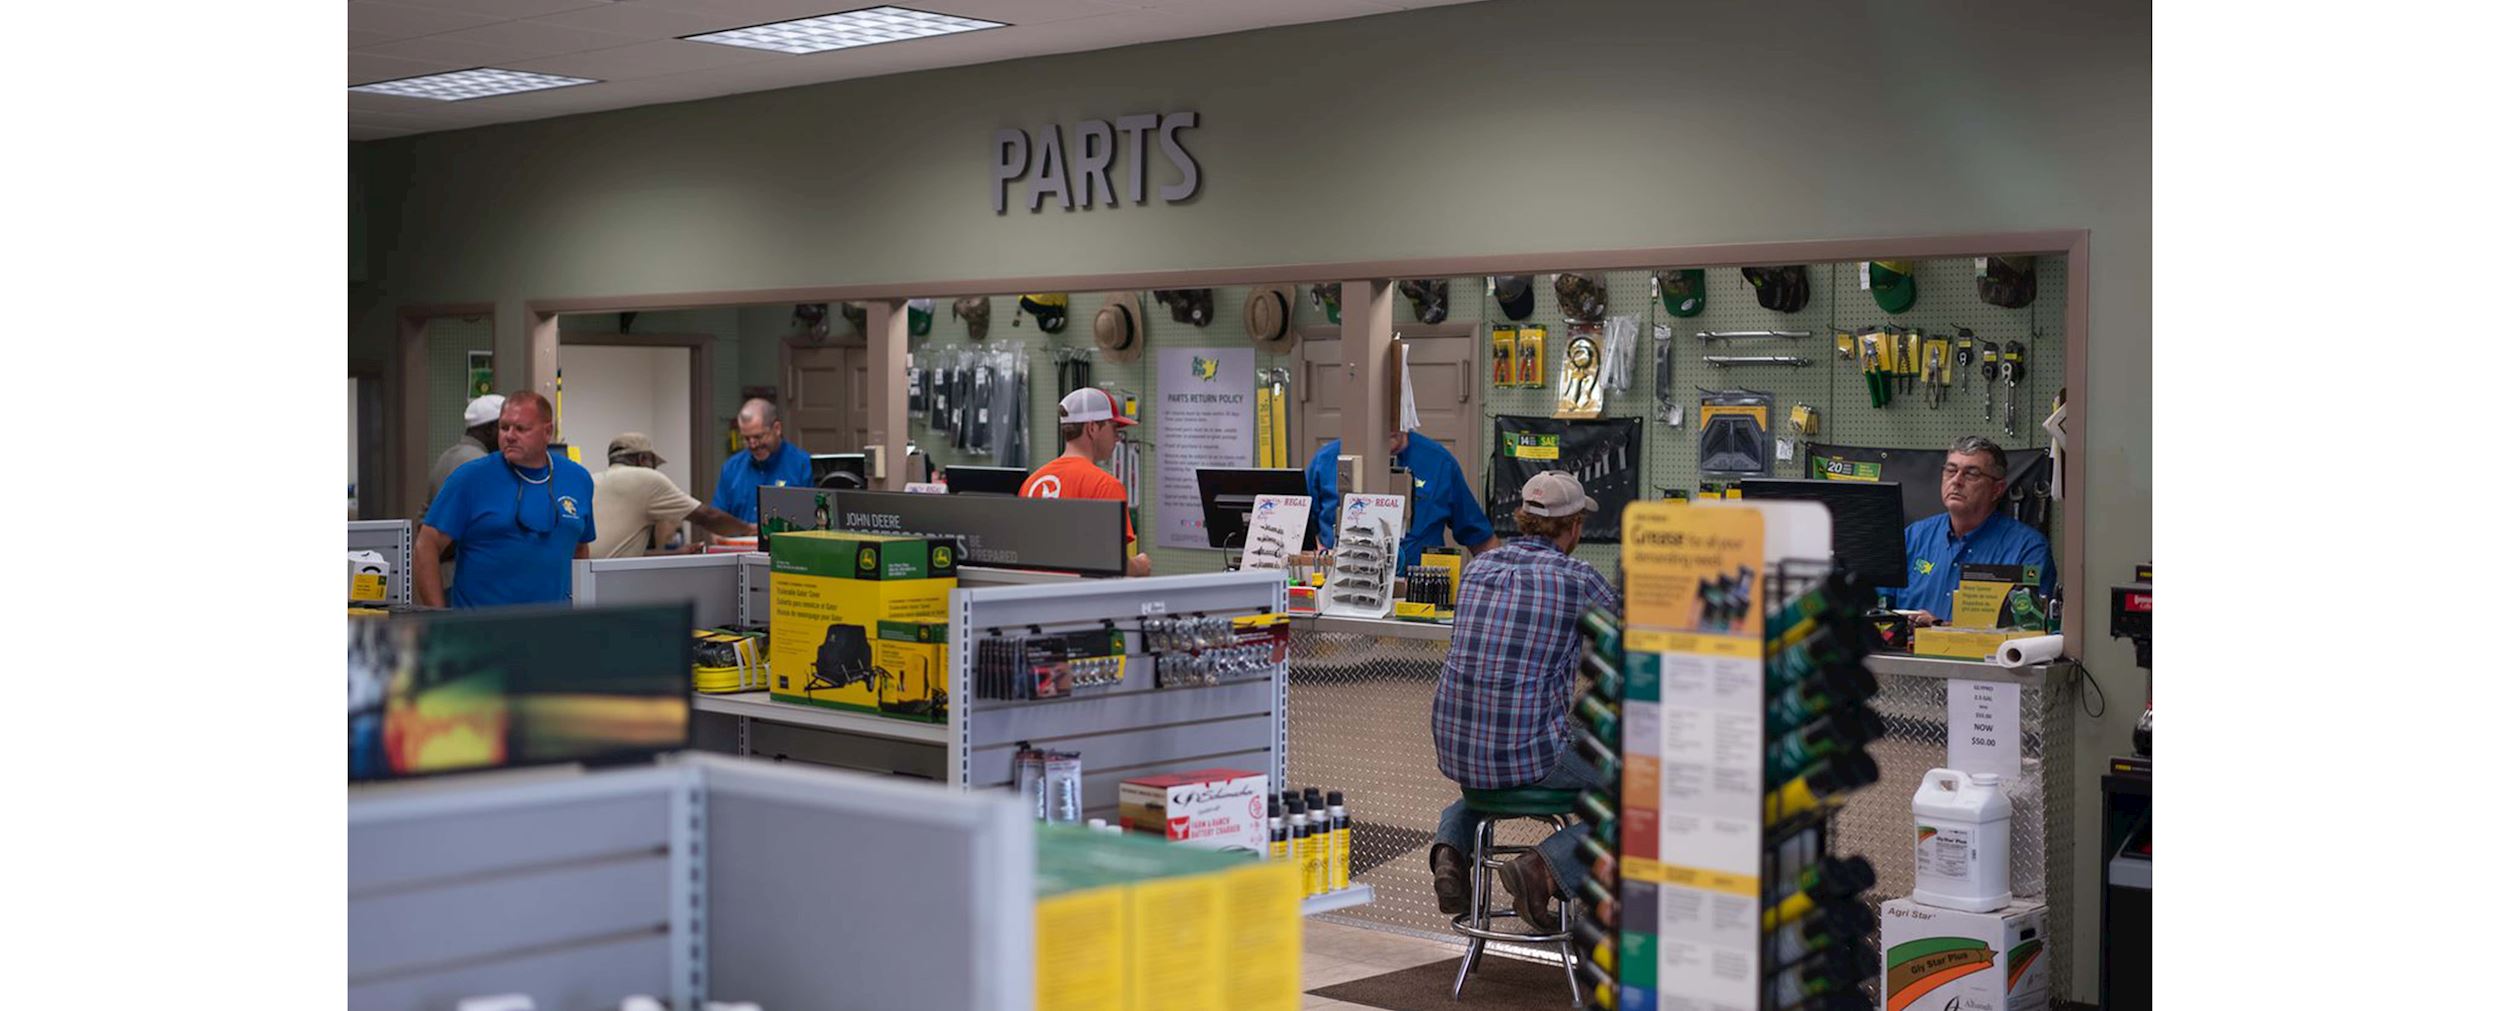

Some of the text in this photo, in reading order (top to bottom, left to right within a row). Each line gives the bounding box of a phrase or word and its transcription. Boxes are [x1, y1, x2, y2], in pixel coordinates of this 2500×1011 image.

[992, 111, 1199, 213] PARTS
[1167, 393, 1243, 404] PARTS RETURN POLICY
[1540, 435, 1557, 446] SAE
[1827, 461, 1843, 473] 20
[1284, 499, 1307, 507] REGAL
[1375, 499, 1399, 508] REGAL
[846, 513, 901, 528] JOHN DEERE
[1630, 524, 1684, 545] Grease
[969, 535, 982, 547] BE
[970, 549, 1018, 563] PREPARED
[1973, 723, 1993, 732] NOW
[1971, 737, 1996, 747] $50.00
[1888, 907, 1909, 919] Agri
[1911, 952, 1968, 975] Gly Star Plus
